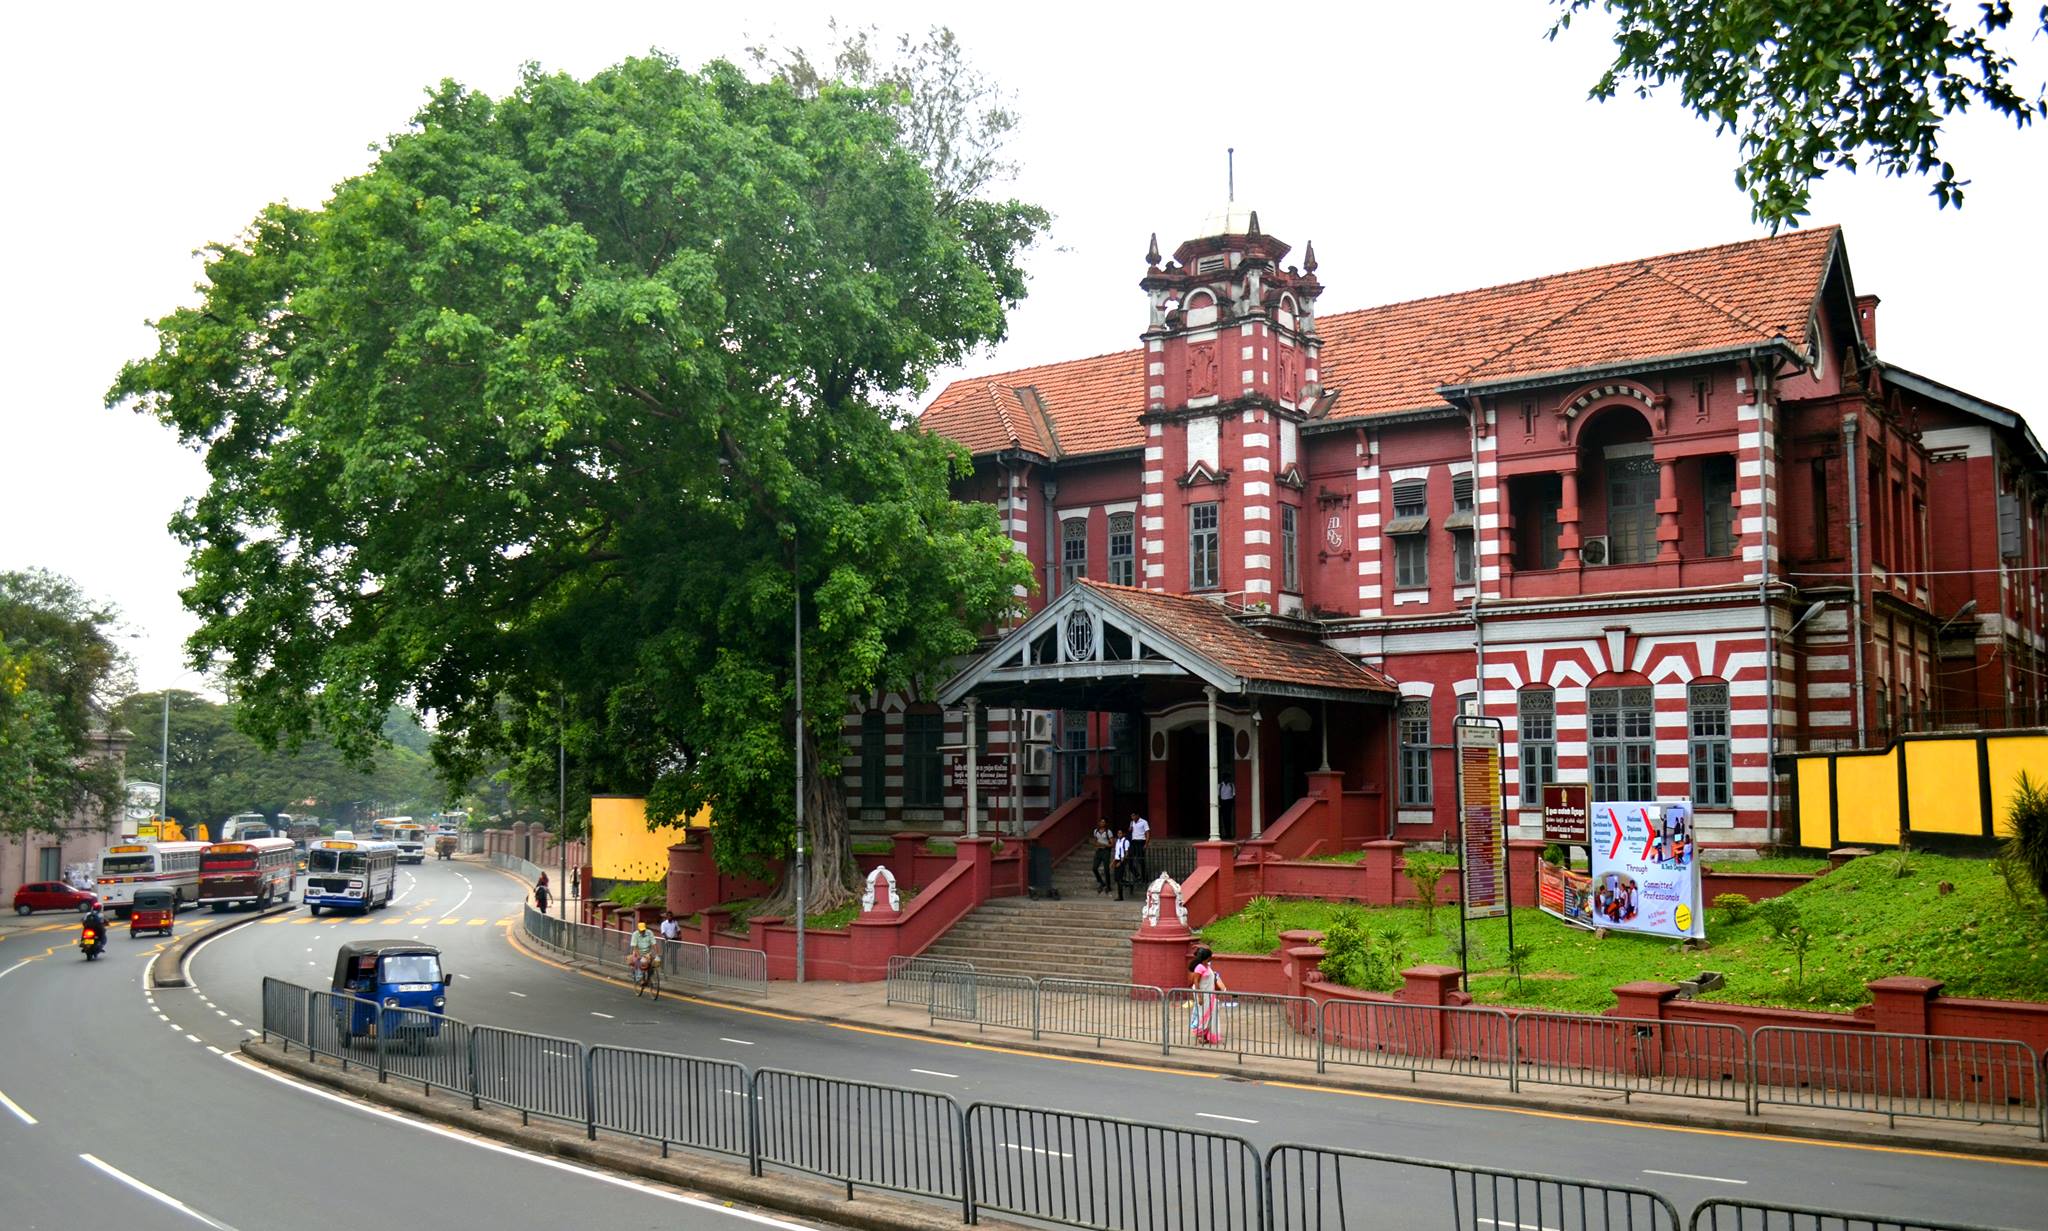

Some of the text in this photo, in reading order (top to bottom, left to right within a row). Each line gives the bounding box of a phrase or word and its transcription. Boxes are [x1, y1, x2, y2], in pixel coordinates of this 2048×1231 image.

[1626, 864, 1648, 875] Through
[1644, 880, 1673, 890] Committed
[1643, 890, 1680, 901] Professionals
